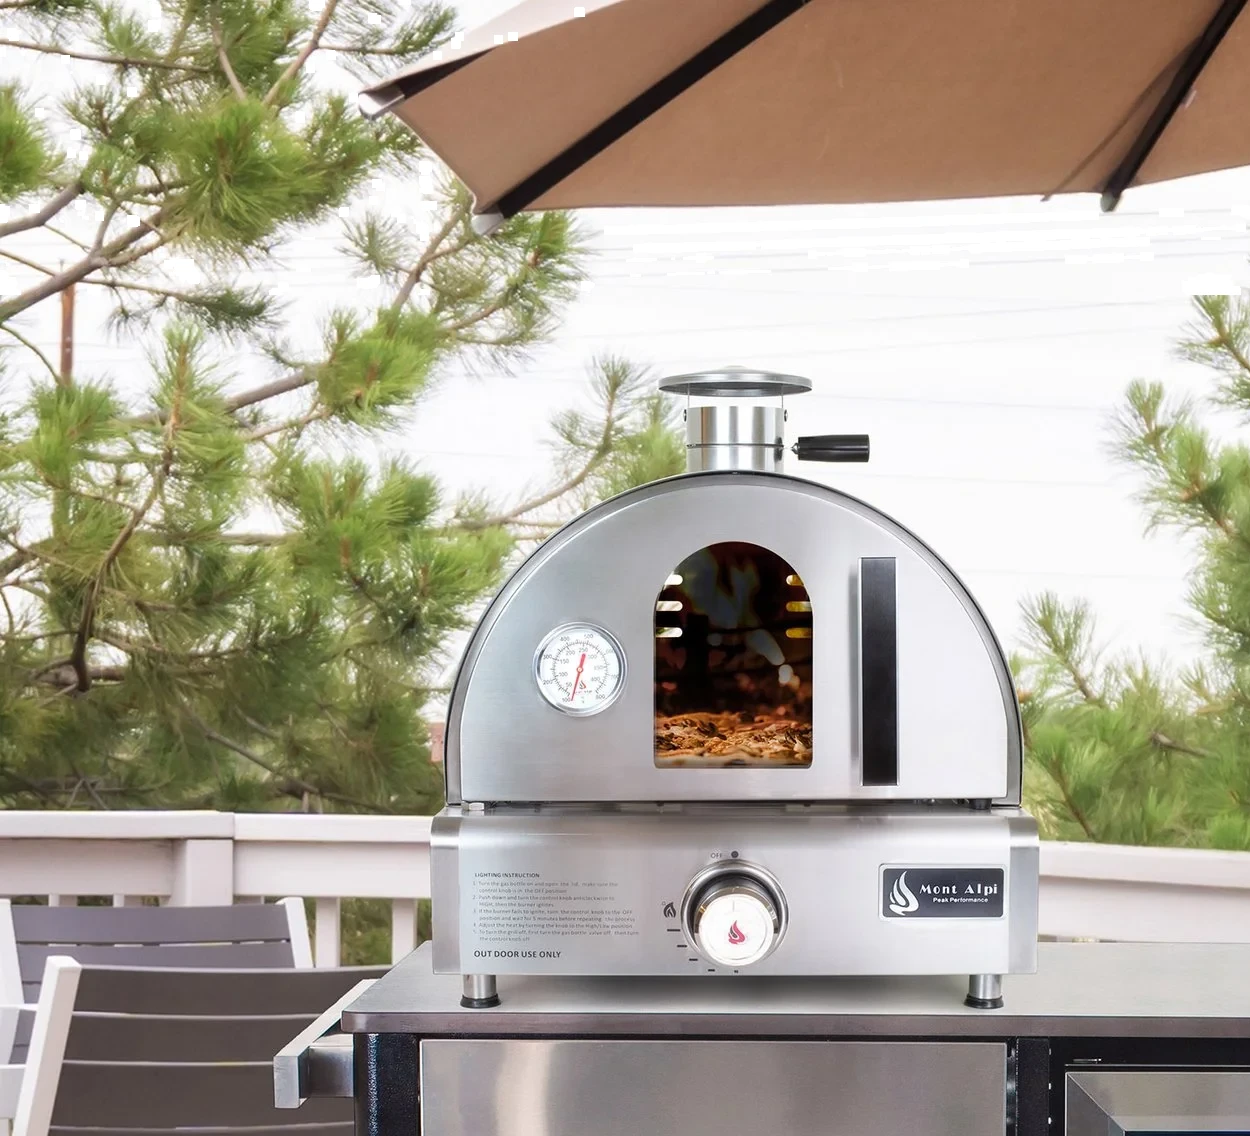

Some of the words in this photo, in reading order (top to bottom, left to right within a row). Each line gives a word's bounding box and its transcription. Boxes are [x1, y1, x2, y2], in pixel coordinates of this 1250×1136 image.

[920, 884, 958, 894] Mont
[964, 884, 998, 896] Alpi
[474, 950, 492, 958] OUT
[494, 950, 519, 958] DOOR
